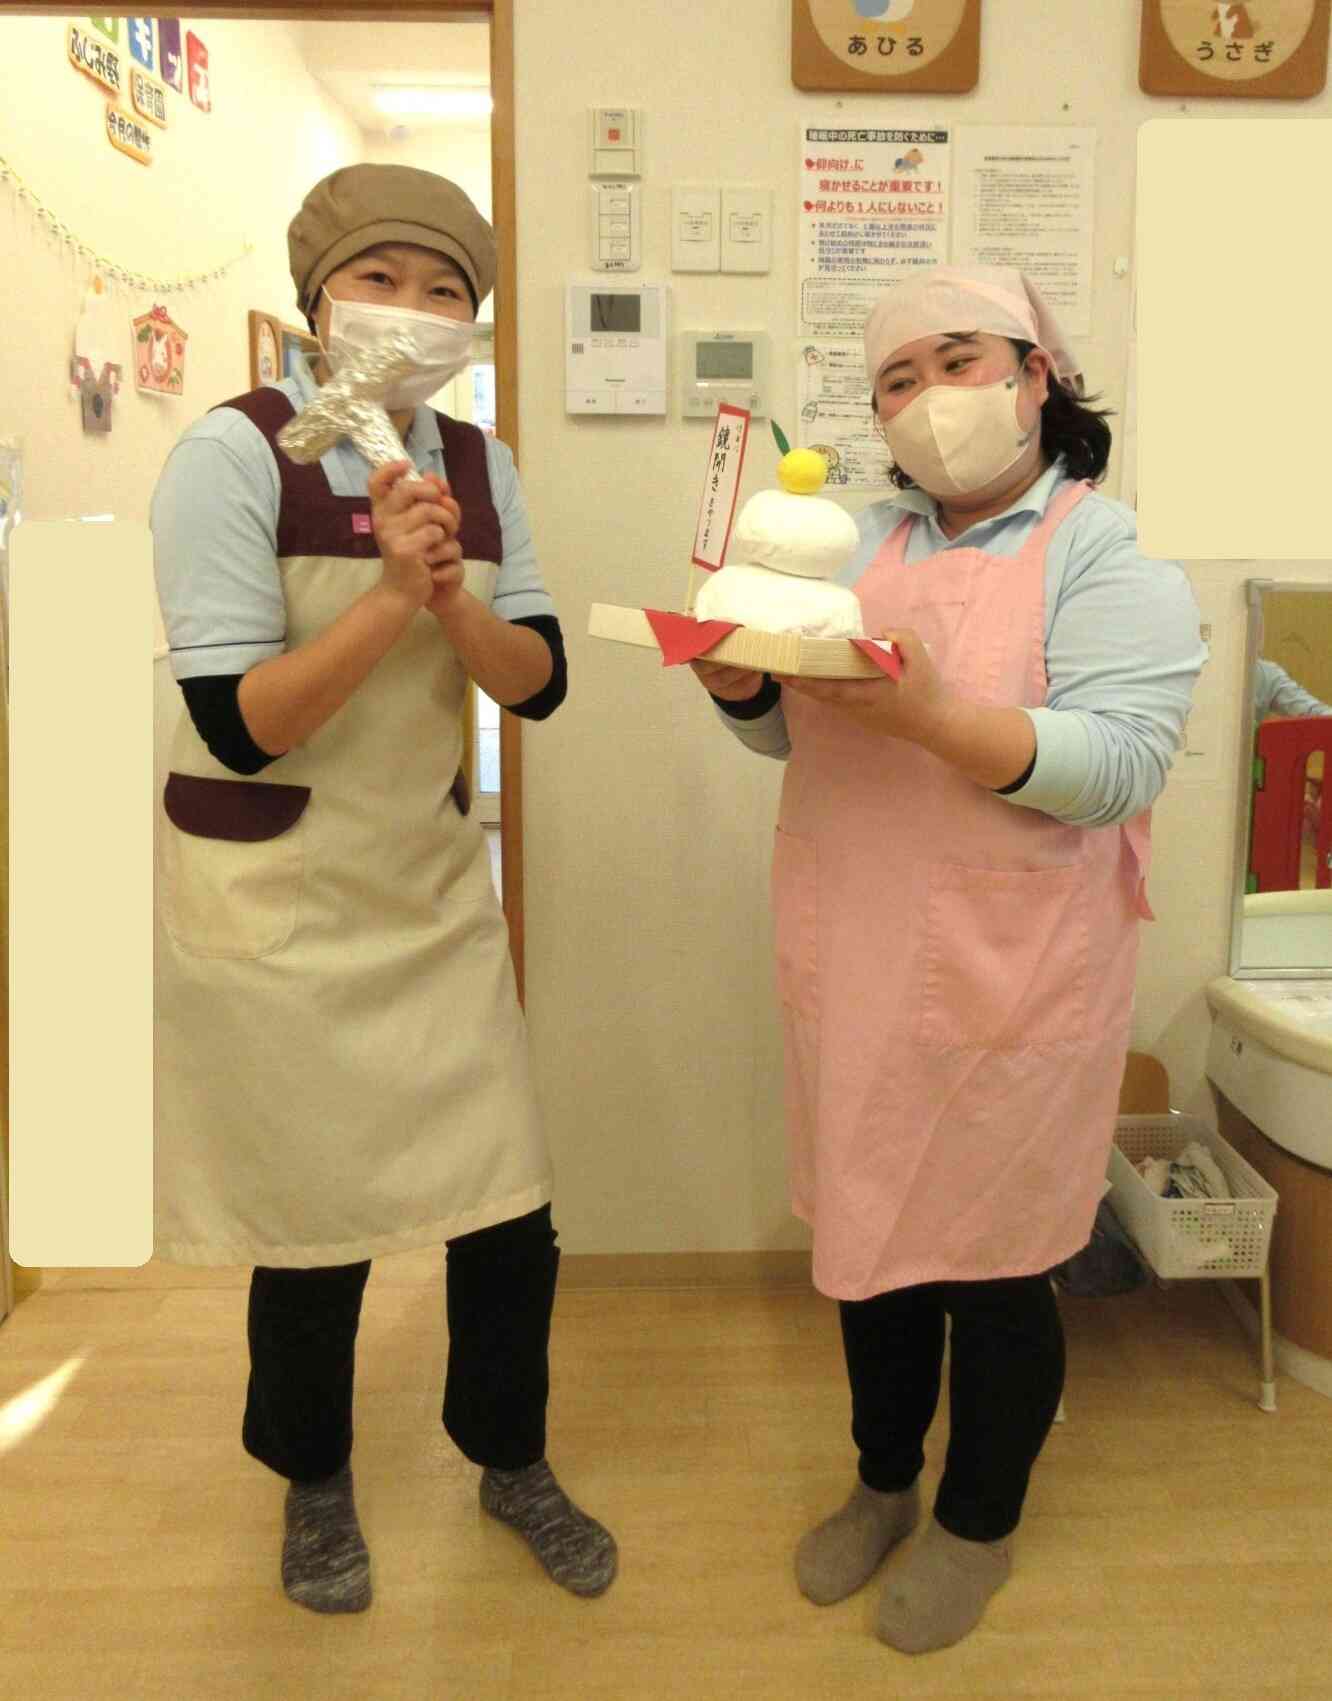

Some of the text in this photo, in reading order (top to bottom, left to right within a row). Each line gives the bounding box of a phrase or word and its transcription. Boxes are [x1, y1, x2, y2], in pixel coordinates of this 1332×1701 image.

[847, 34, 925, 56] あひる
[1197, 41, 1275, 63] うさぎ
